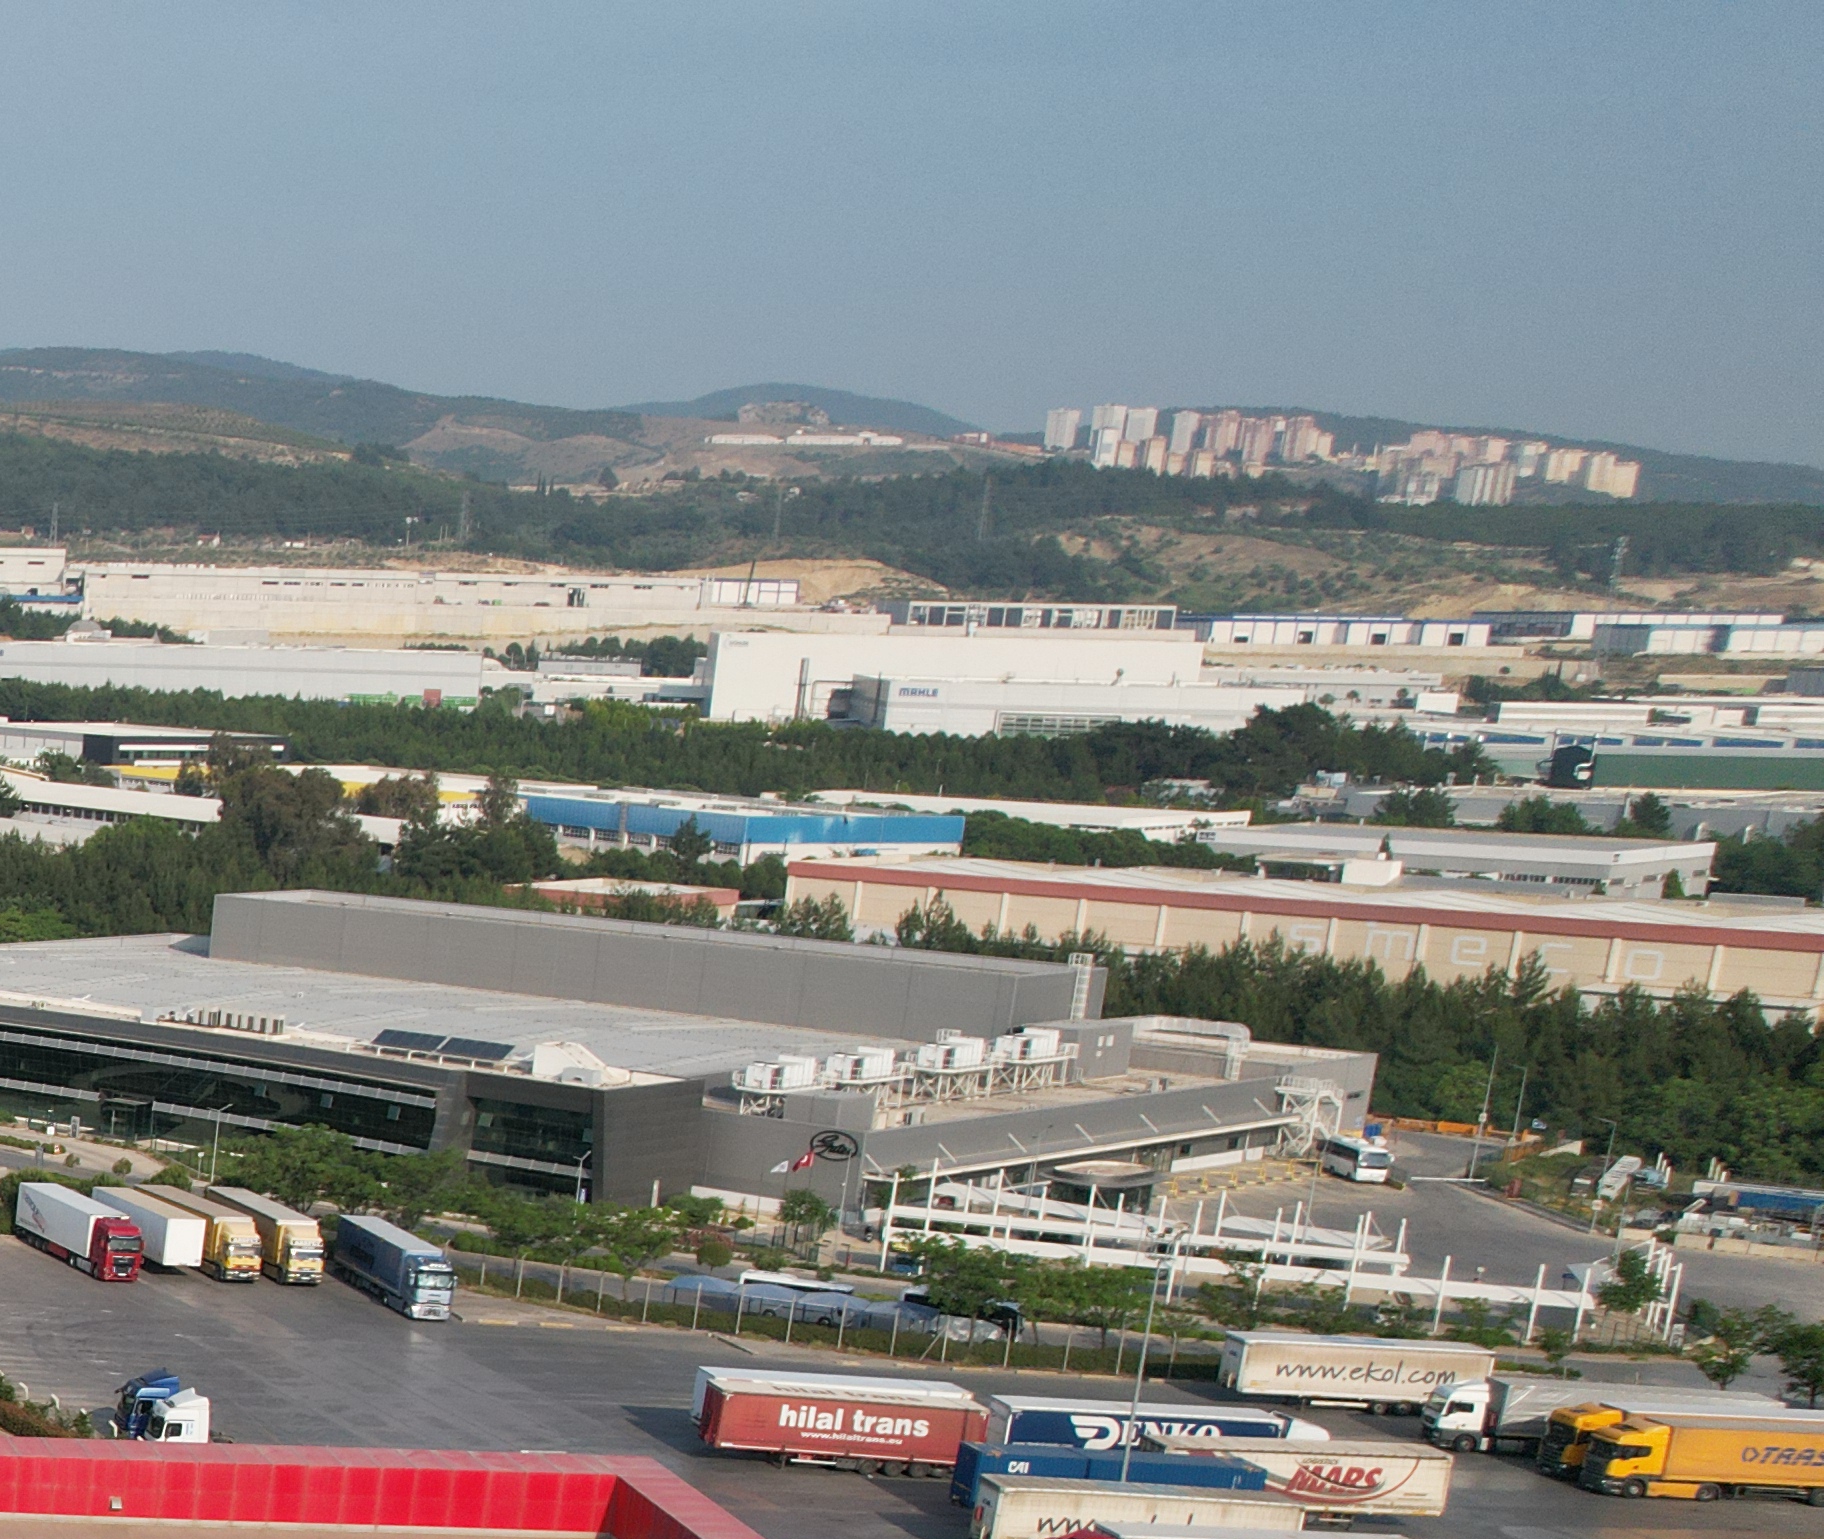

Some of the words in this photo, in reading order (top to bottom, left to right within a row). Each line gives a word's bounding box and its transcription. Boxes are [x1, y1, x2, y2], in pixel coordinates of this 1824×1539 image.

[898, 687, 939, 698] MAHLE
[1276, 1360, 1456, 1385] www.ekol.com
[779, 1404, 844, 1430] hilal
[853, 1409, 930, 1438] trans
[1287, 1463, 1386, 1493] MARS
